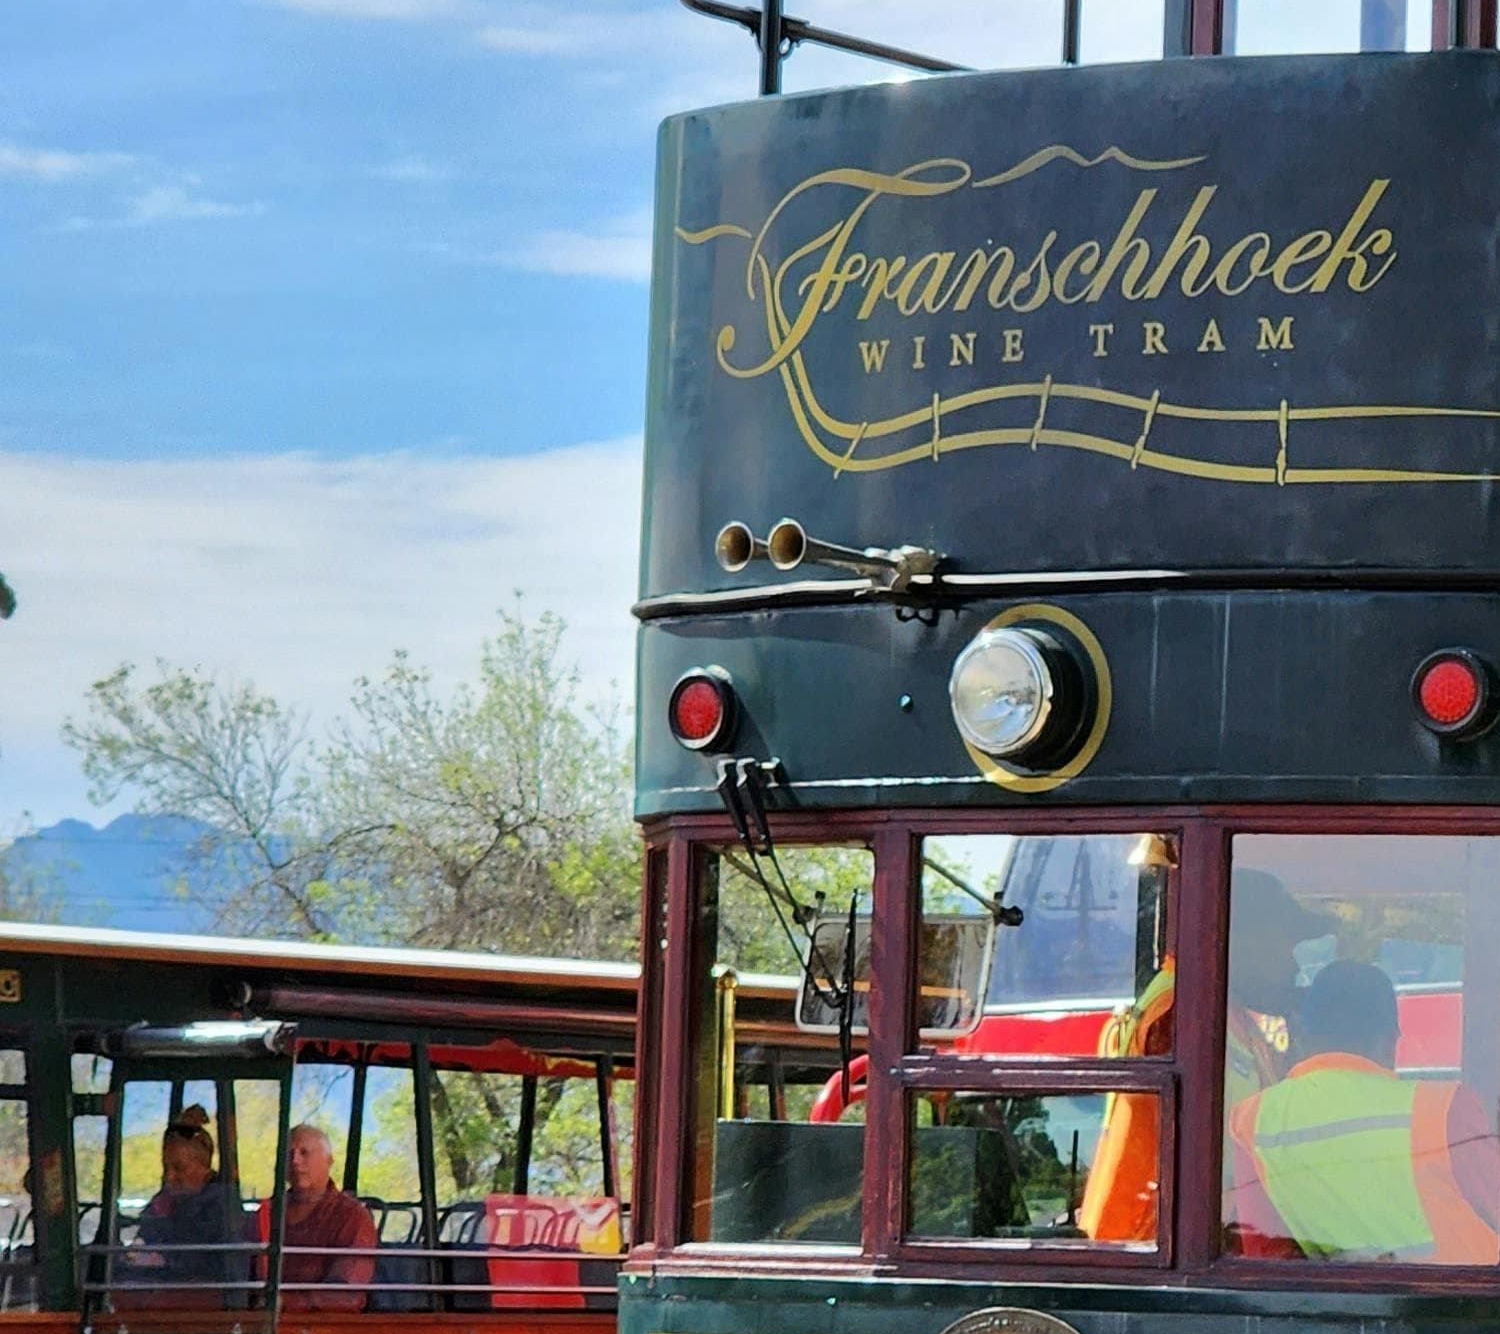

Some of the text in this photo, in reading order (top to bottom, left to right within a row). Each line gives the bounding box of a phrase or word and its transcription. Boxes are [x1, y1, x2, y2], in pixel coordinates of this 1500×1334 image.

[717, 157, 1397, 378] Franschhoek
[860, 316, 1295, 374] WINE TRAM
